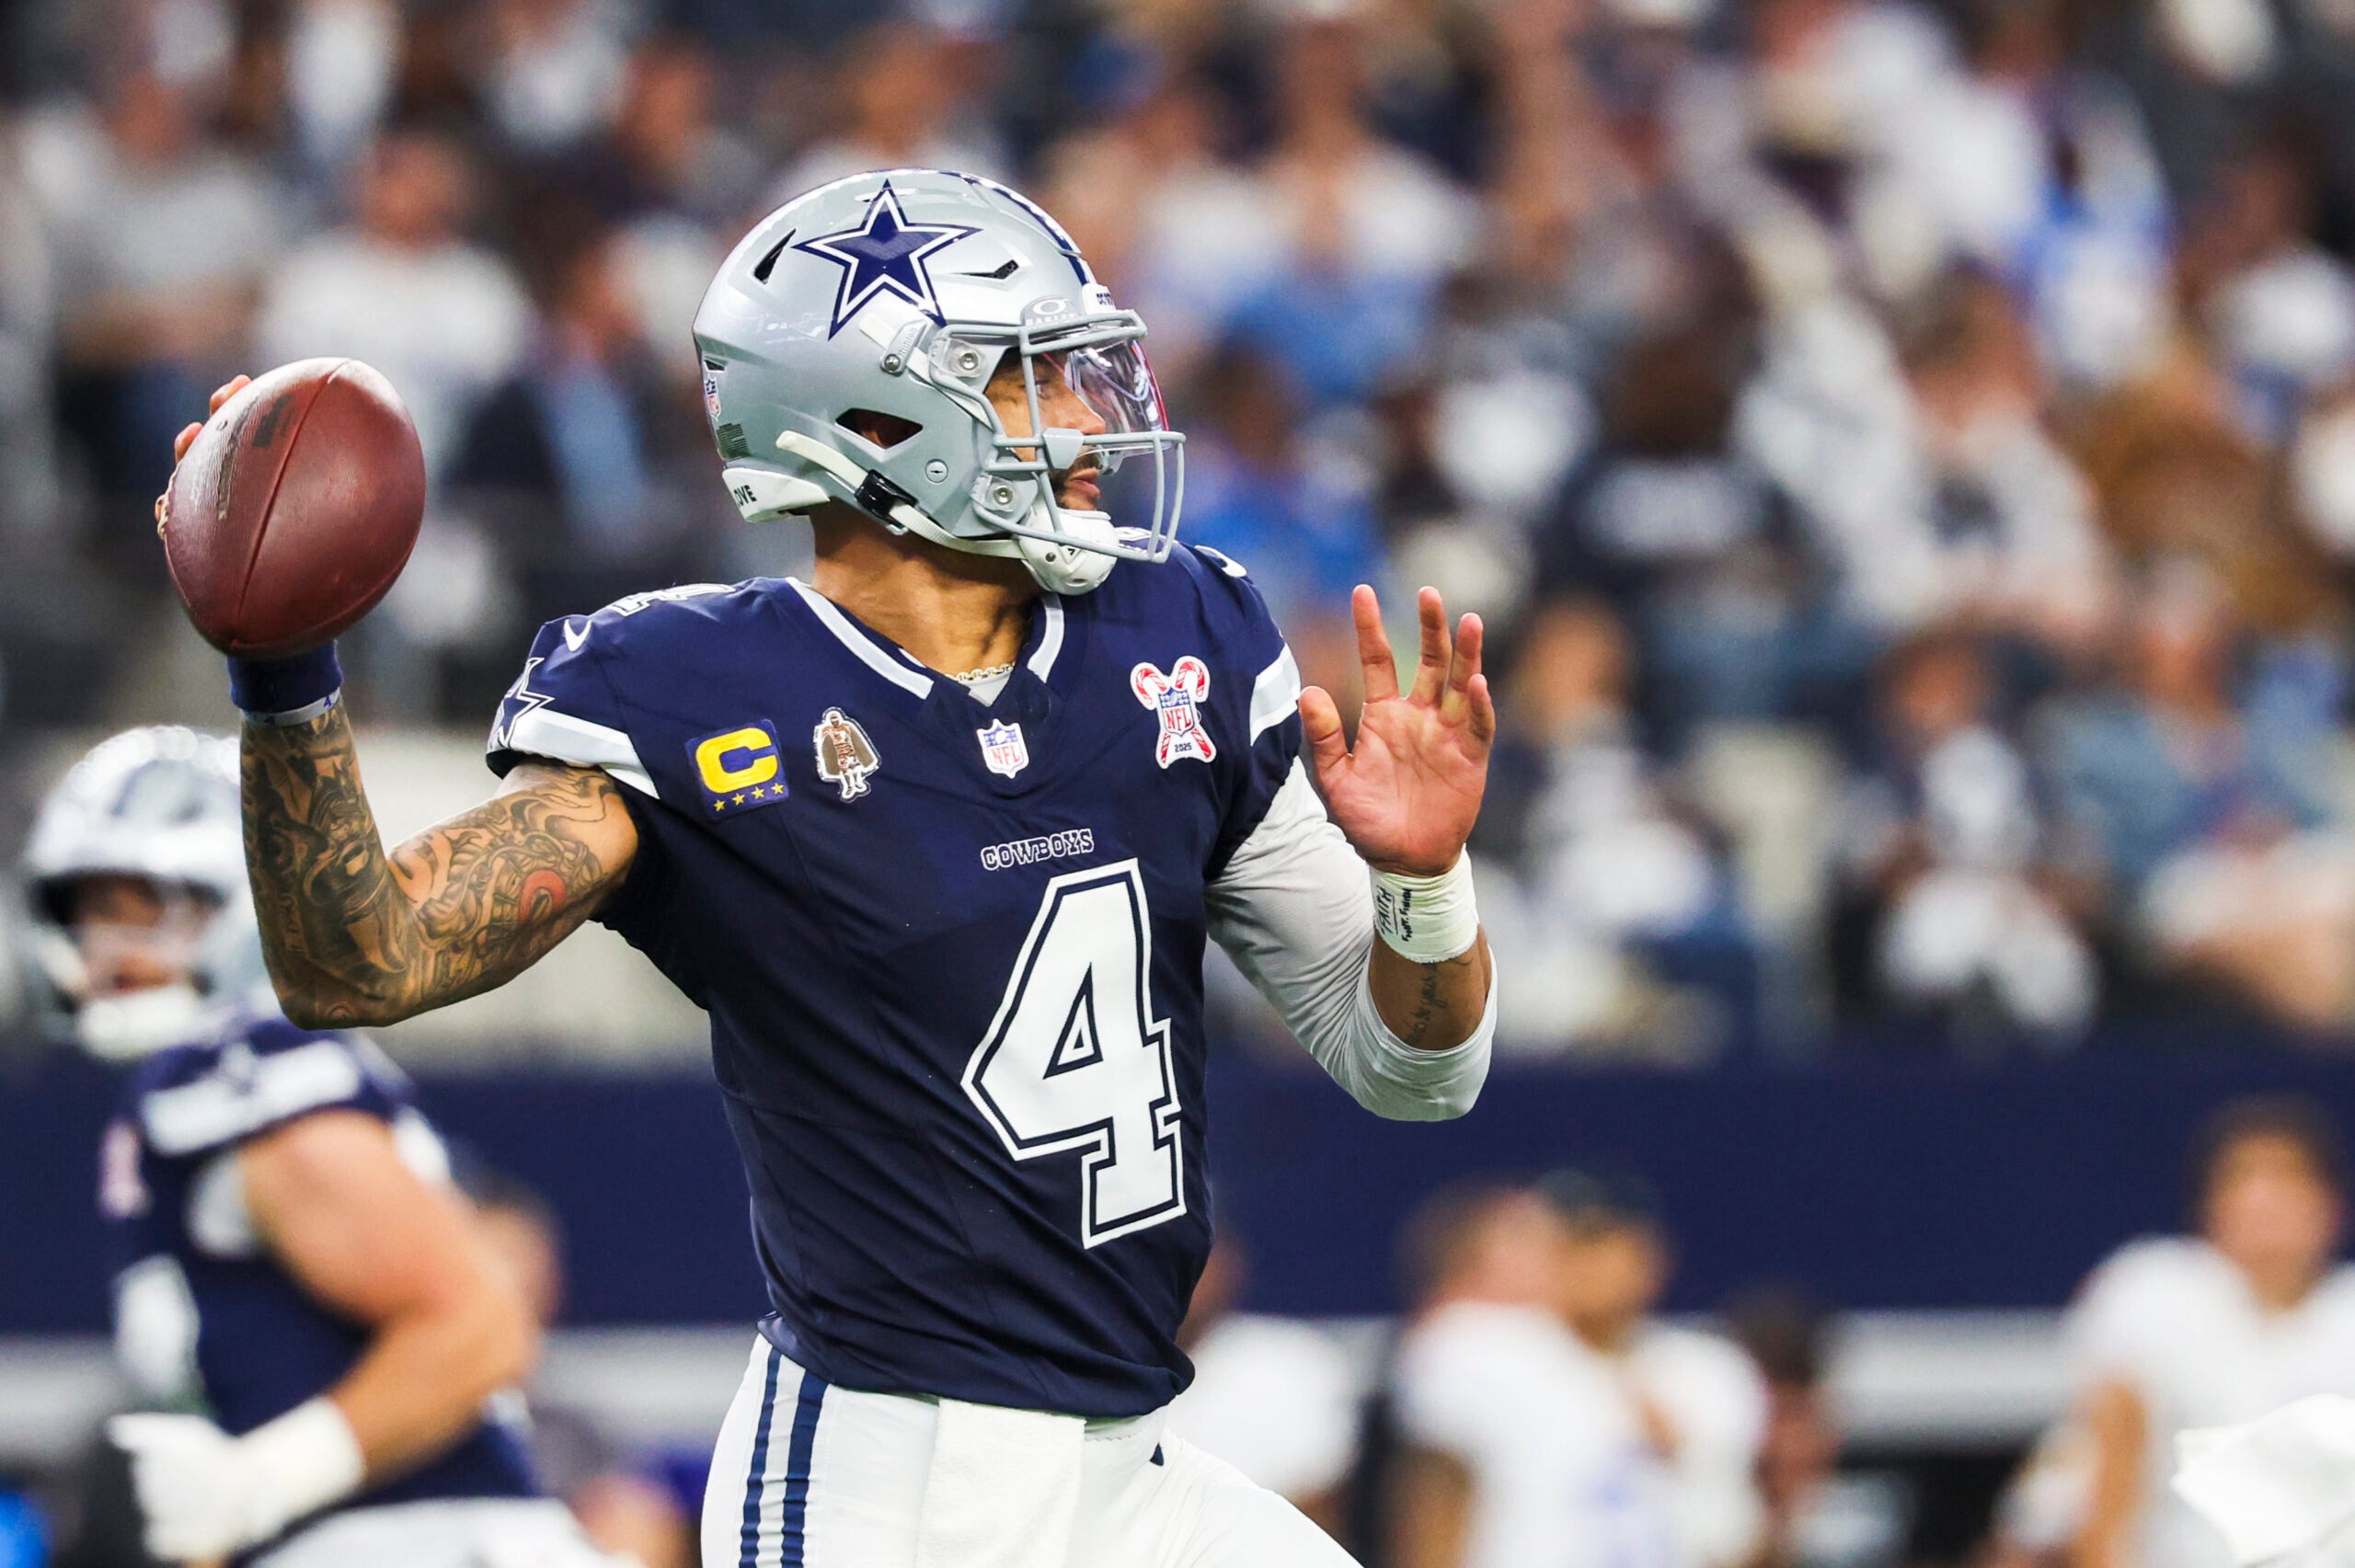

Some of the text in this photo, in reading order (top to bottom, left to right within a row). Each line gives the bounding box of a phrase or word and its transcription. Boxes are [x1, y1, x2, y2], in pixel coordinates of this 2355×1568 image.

[1164, 706, 1192, 731] NFL
[695, 727, 779, 795] C
[991, 745, 1021, 765] NFL
[1174, 742, 1193, 752] 2025
[980, 828, 1095, 871] COWBOYS
[960, 857, 1187, 1250] 4
